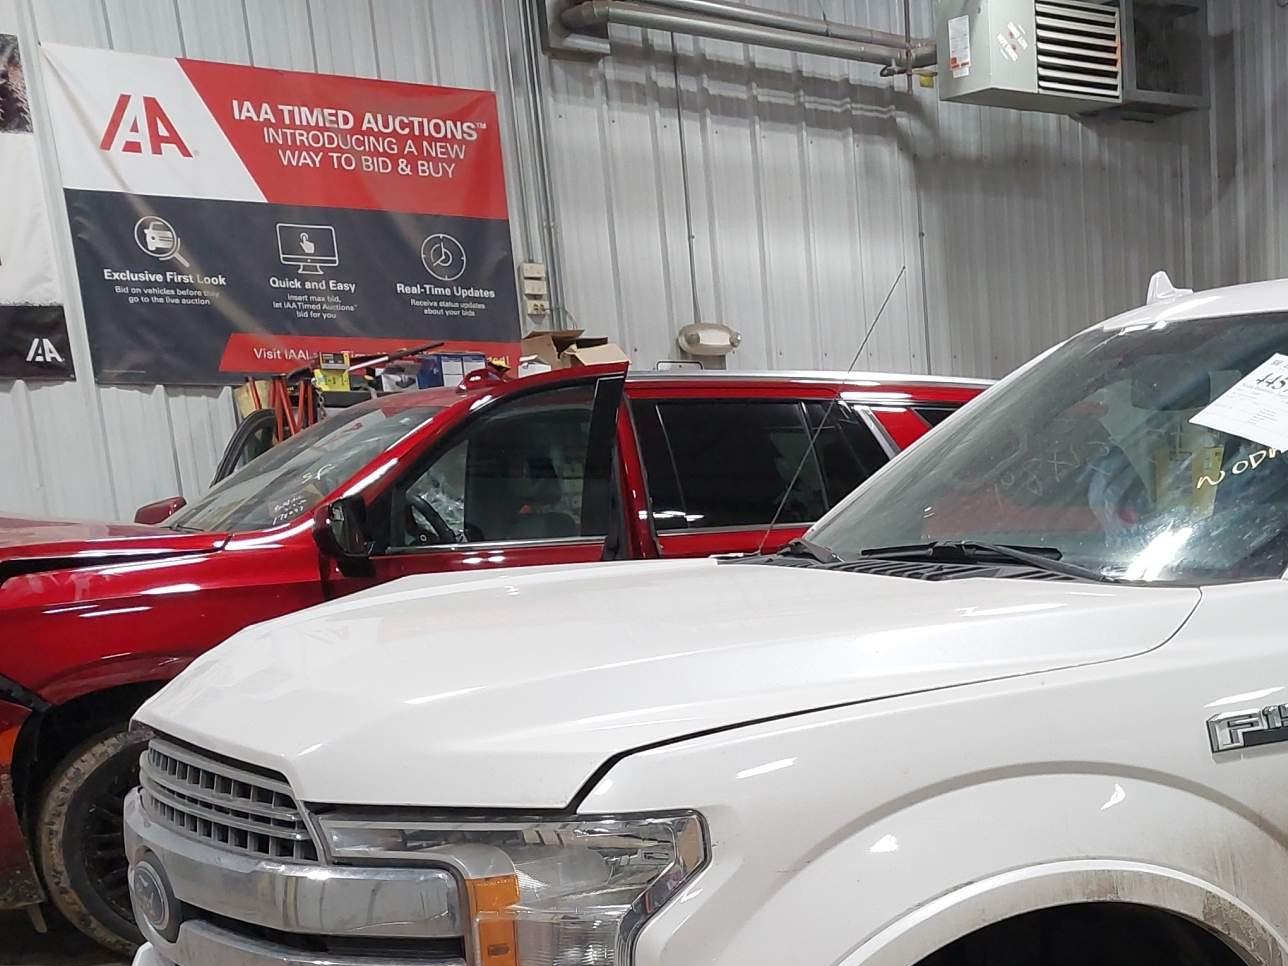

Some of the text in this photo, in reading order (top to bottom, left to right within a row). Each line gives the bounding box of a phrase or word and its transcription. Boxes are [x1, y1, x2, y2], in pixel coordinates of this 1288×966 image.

[232, 99, 275, 122] IAA
[278, 105, 354, 130] TIMED
[263, 126, 466, 160] INTRODUCING A NEW
[278, 149, 456, 179] WAY TO BID & BUY
[103, 268, 227, 286] Exclusive First Look
[269, 276, 356, 293] Quick and Easy
[114, 285, 129, 294] Bid
[143, 287, 176, 296] vehicles
[176, 288, 202, 297] before
[396, 283, 496, 299] Real-Time Updates
[128, 296, 210, 305] go to the live auction
[253, 347, 282, 360] Visit
